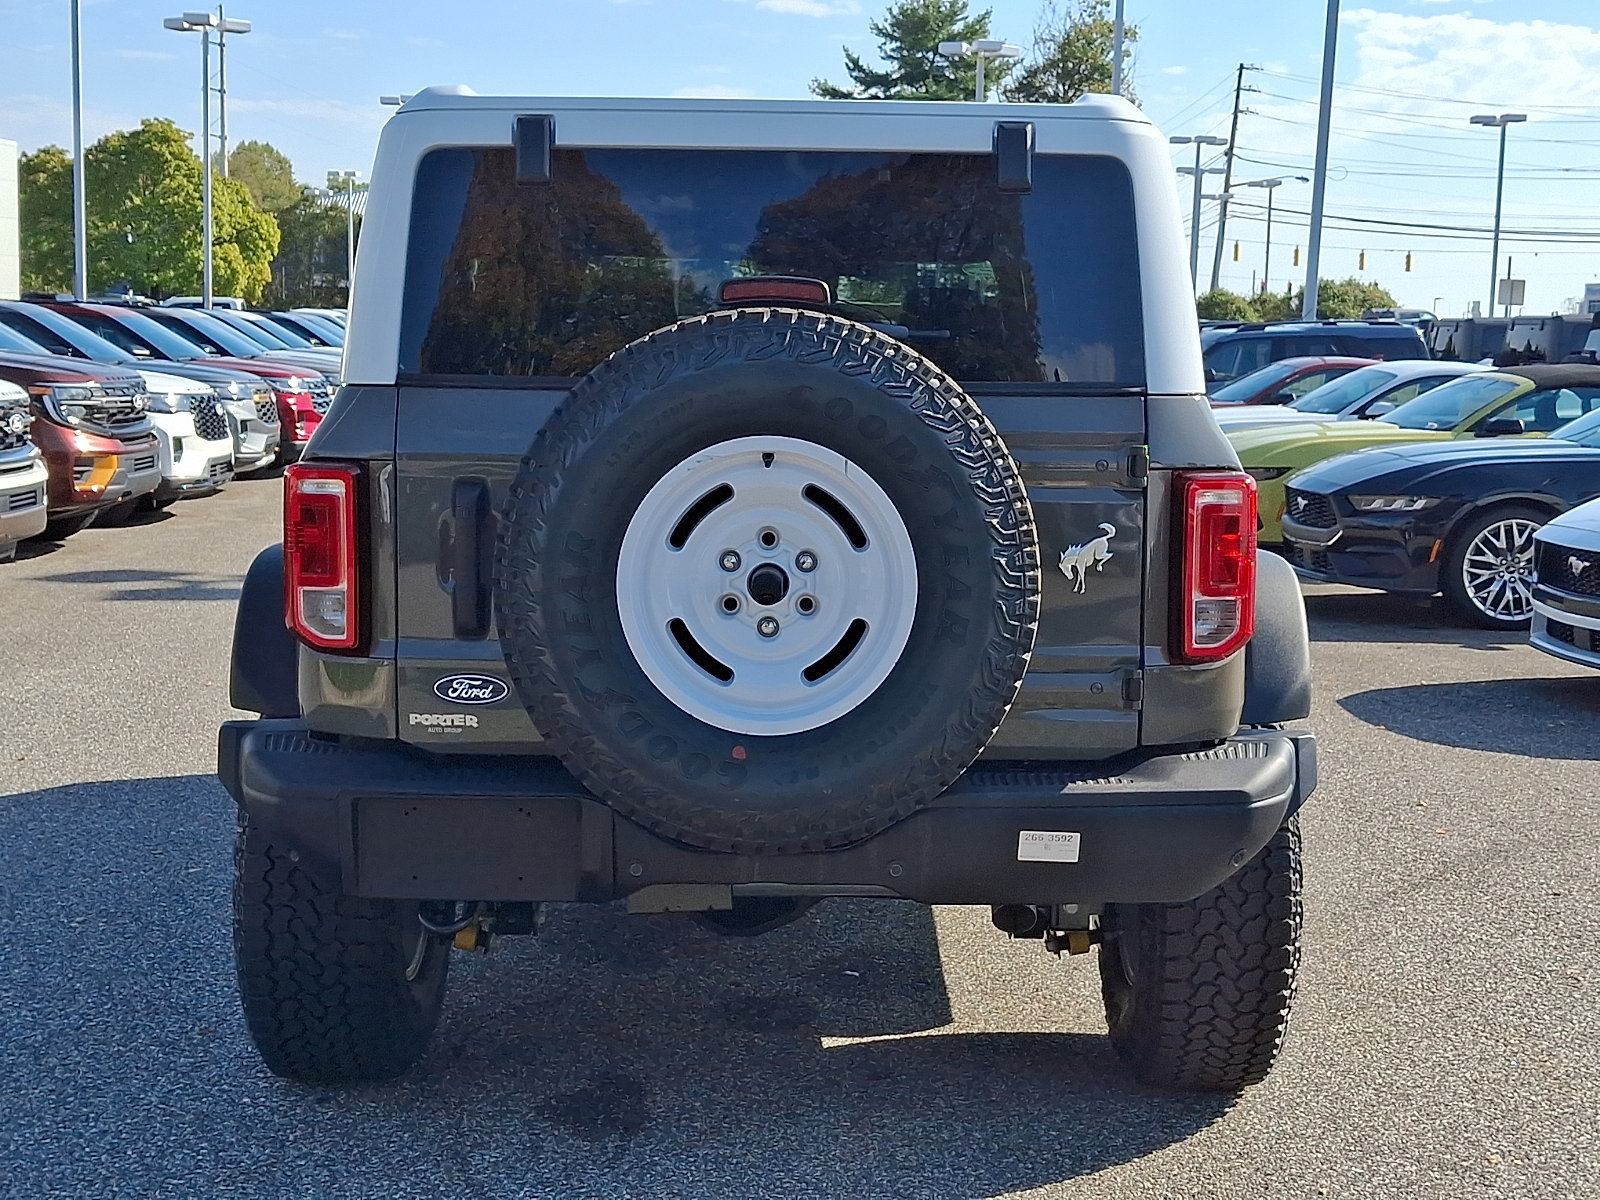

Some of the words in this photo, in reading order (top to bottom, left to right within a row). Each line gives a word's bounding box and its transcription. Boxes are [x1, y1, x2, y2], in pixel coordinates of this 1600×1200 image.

[448, 679, 494, 699] Ford
[408, 713, 479, 728] PORTER
[1047, 834, 1074, 843] 3592
